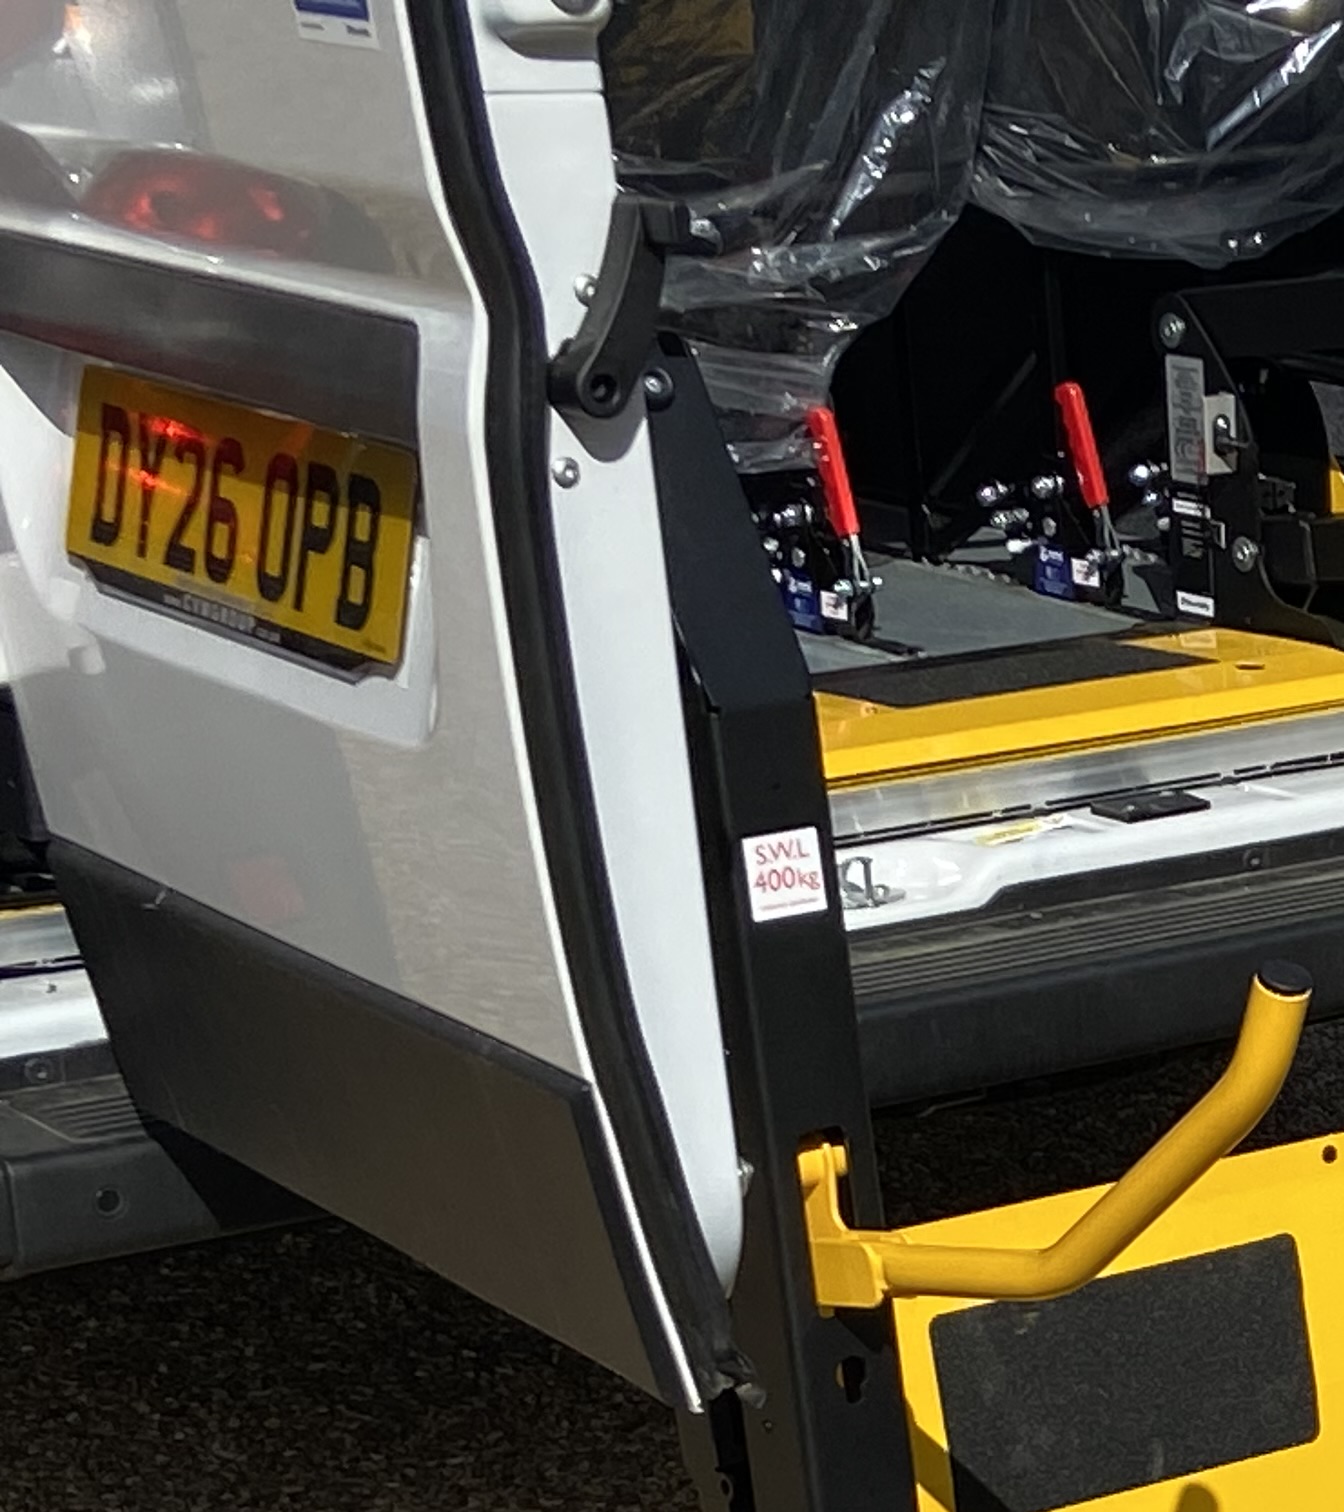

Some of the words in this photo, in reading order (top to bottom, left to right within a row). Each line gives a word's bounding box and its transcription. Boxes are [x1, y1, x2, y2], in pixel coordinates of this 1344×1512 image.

[90, 402, 246, 585] DY26
[257, 452, 382, 631] OPB
[752, 866, 821, 893] 400kg
